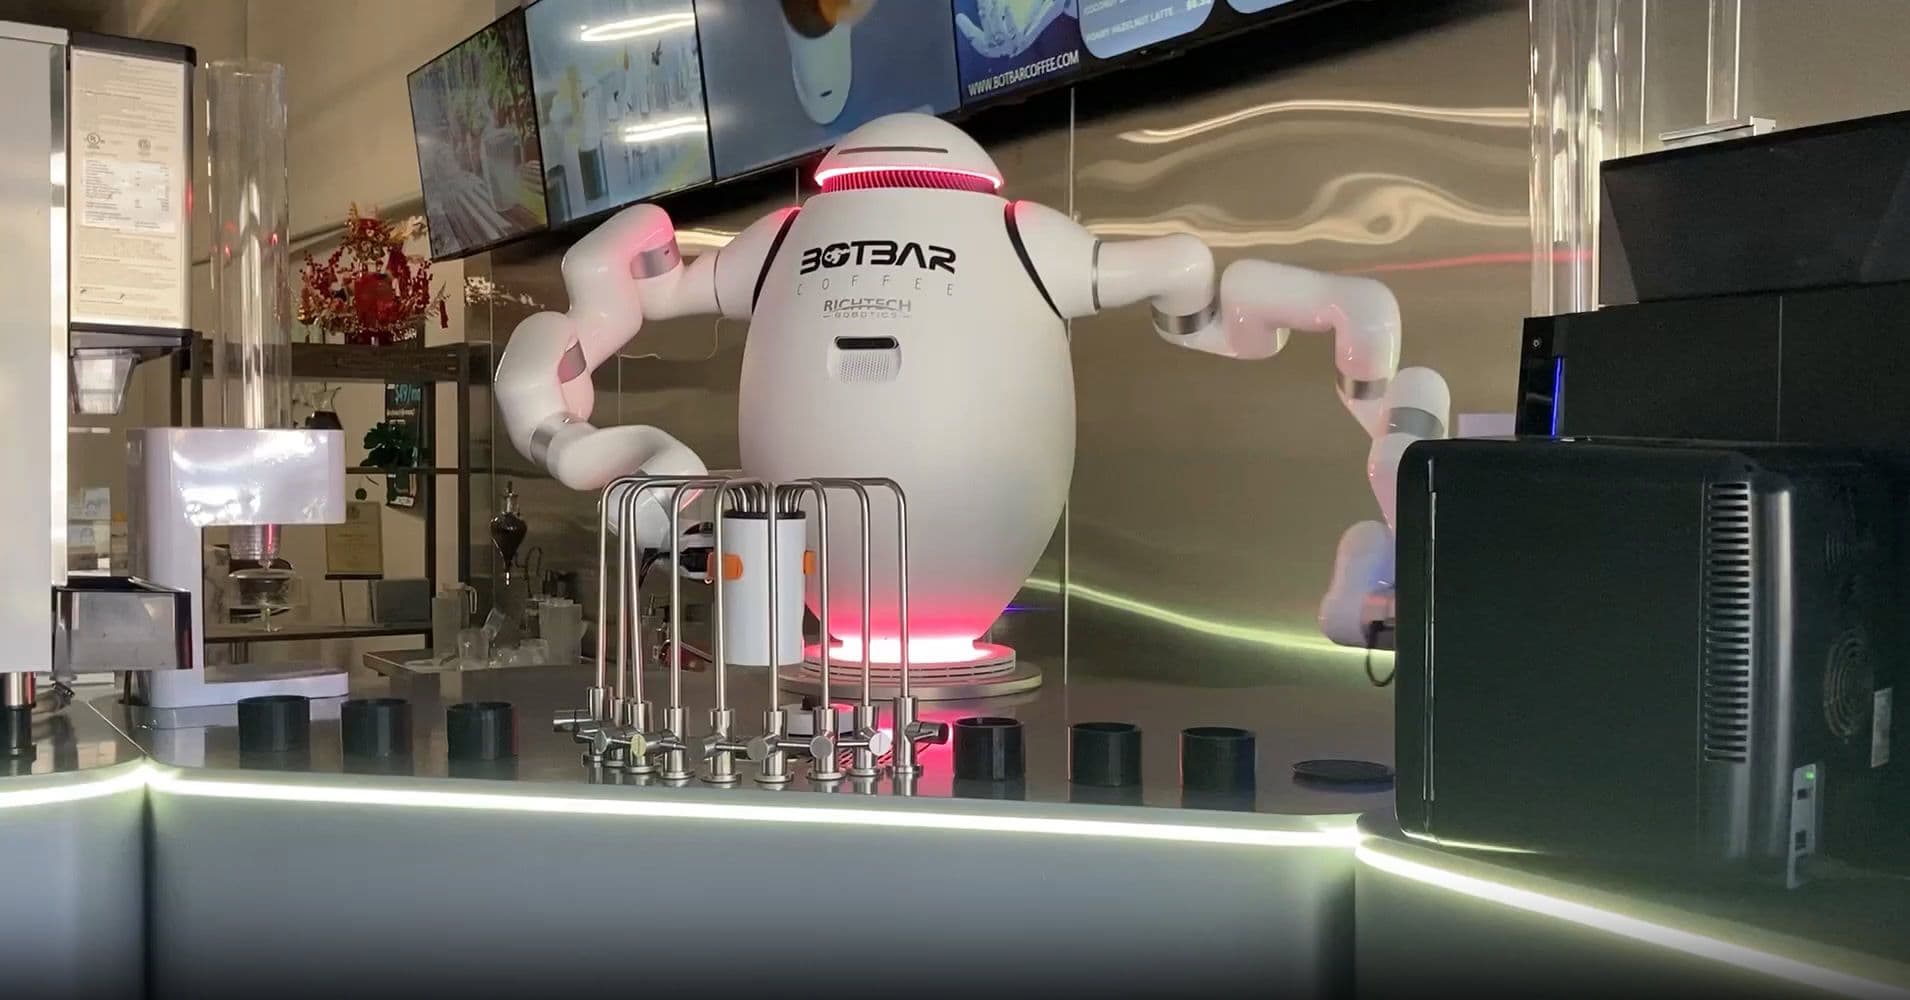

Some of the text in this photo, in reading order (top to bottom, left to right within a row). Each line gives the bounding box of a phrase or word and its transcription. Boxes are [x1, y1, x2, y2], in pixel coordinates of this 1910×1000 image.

[968, 49, 1080, 97] WWW.BOTBARCOFFEE.COM
[800, 240, 956, 275] BOTBAR
[796, 274, 954, 297] COFFEE
[823, 298, 911, 313] RICHTECH
